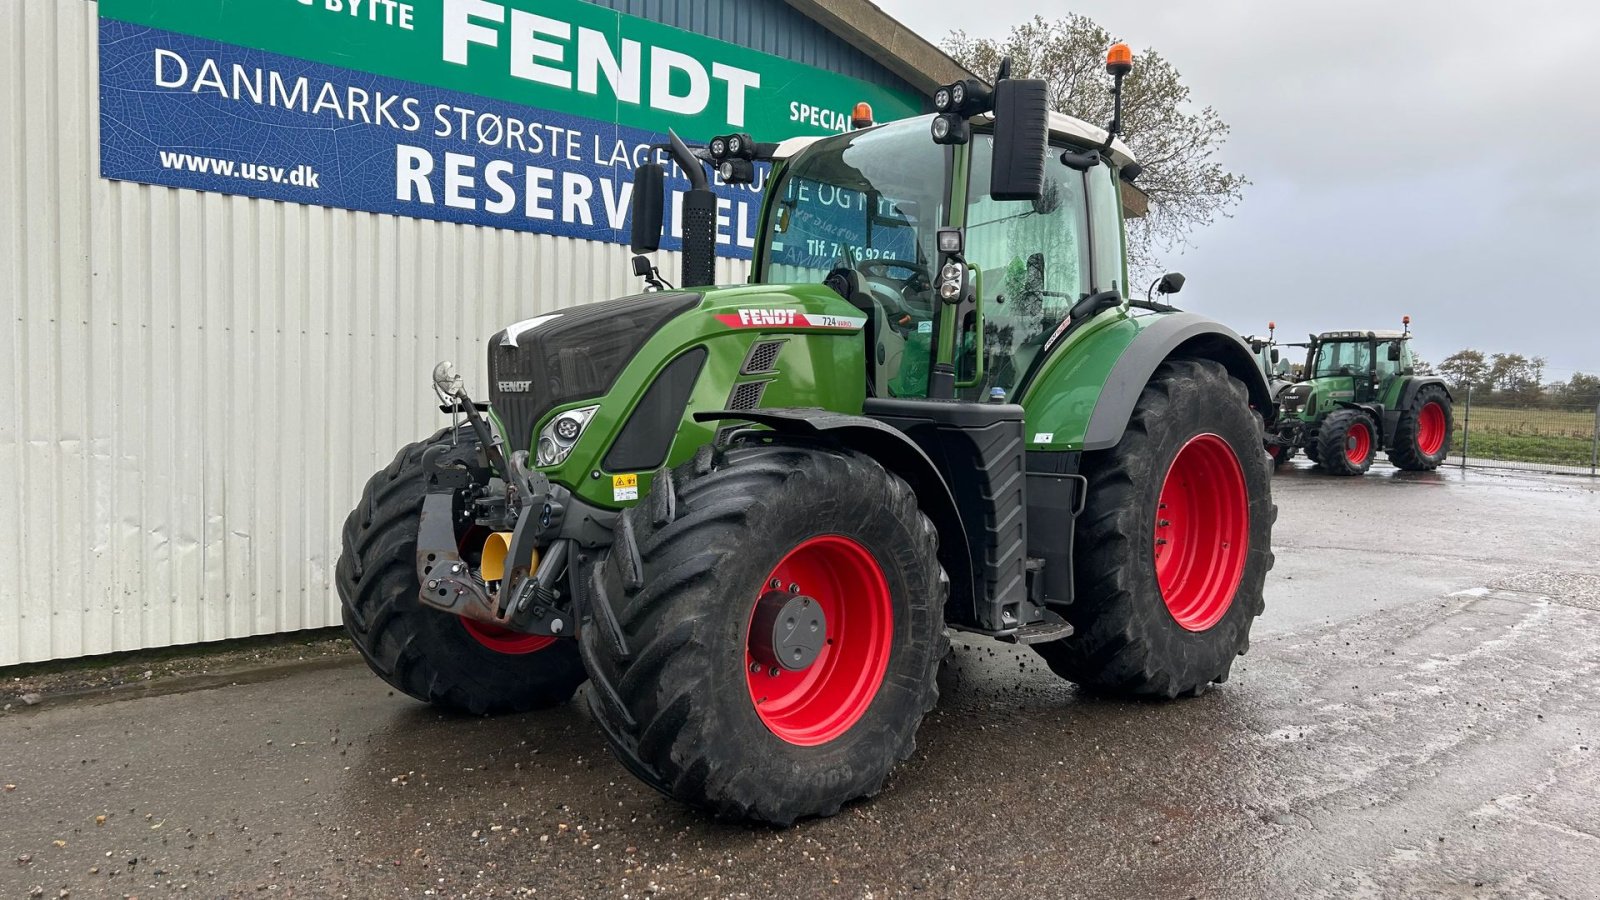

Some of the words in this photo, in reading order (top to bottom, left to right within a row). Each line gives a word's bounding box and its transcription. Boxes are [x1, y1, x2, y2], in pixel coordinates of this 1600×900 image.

[442, 0, 760, 127] FENDT
[154, 48, 420, 132] DANMARKS
[434, 104, 581, 161] STØRSTE
[789, 101, 881, 133] SPECIAL
[159, 151, 319, 188] www.usv.dk
[806, 240, 827, 257] Tlf.
[738, 309, 797, 325] FENDT
[822, 317, 836, 326] 724
[498, 381, 532, 393] FENDT
